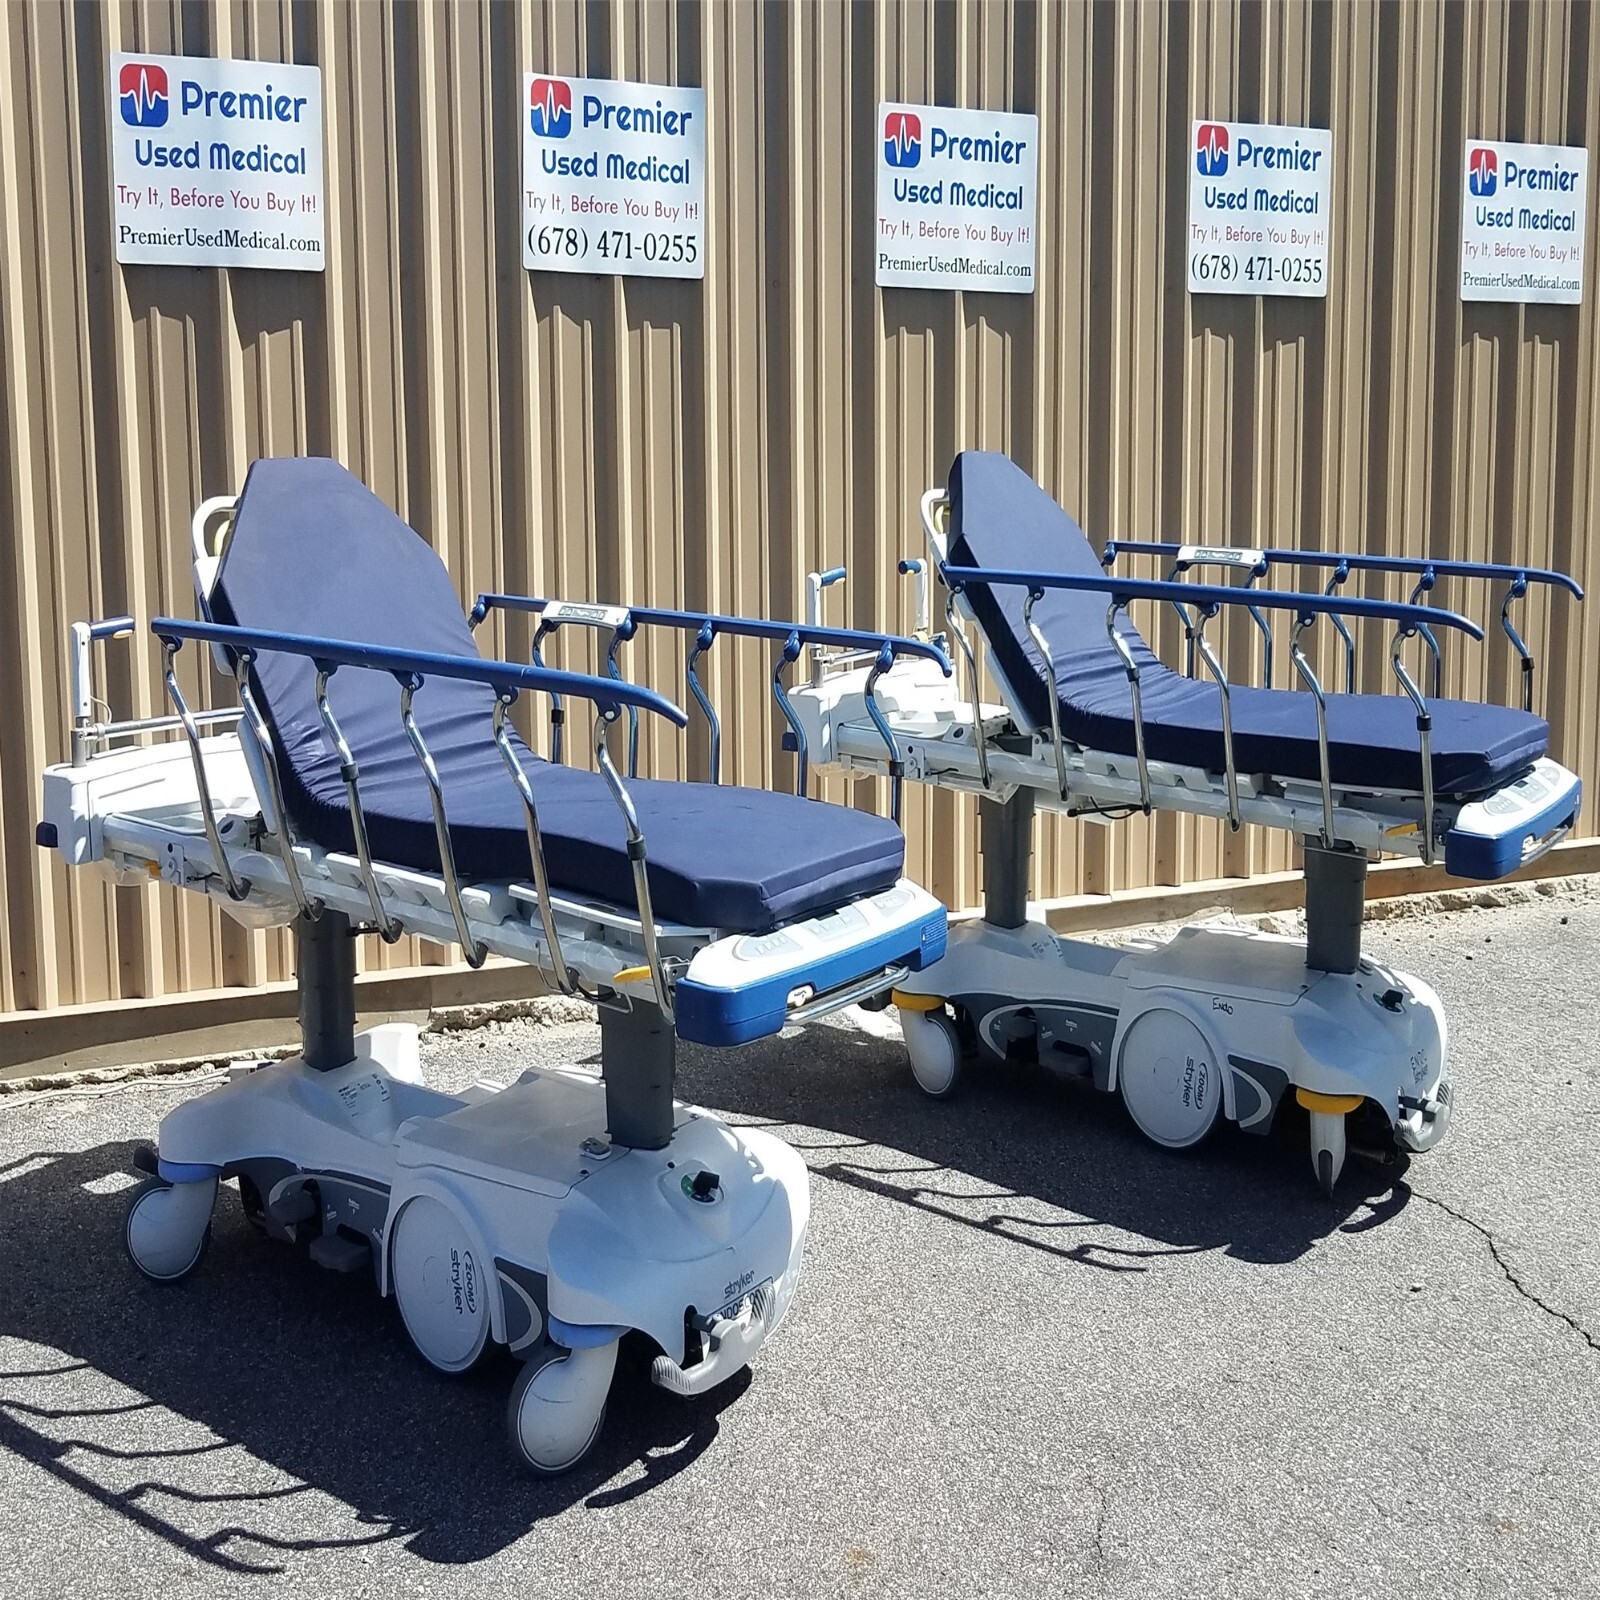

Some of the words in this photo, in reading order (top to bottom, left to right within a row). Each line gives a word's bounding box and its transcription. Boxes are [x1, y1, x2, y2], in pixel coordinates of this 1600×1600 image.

[181, 80, 308, 123] Premier
[583, 95, 693, 136] Premier
[135, 139, 200, 170] Used
[210, 142, 306, 175] Medical
[930, 128, 1026, 165] Premier
[1237, 138, 1322, 172] Premier
[542, 148, 598, 178] Used
[606, 153, 690, 184] Medical
[1504, 161, 1579, 192] Premier
[117, 185, 142, 209] Try
[148, 186, 164, 209] It,
[170, 188, 224, 208] Before
[230, 190, 260, 210] You
[267, 192, 296, 216] Buy
[302, 194, 316, 213] It!
[526, 191, 547, 214] Try
[552, 194, 565, 215] It,
[571, 195, 618, 214] Before
[623, 198, 649, 217] You
[654, 201, 680, 224] Buy
[685, 202, 698, 220] It!
[894, 178, 942, 204] Used
[950, 182, 1023, 210] Medical
[1204, 186, 1248, 210] Used
[1254, 188, 1319, 214] Medical
[878, 218, 897, 240] Try
[902, 220, 914, 240] It,
[919, 220, 960, 240] Before
[964, 224, 986, 241] You
[991, 226, 1014, 246] Buy
[1018, 227, 1030, 244] It!
[1476, 206, 1514, 228] Used
[1518, 208, 1576, 232] Medical
[119, 225, 321, 252] PremierUsedMedical.com
[528, 224, 589, 259] (678)
[596, 230, 698, 264] 471-0255
[1191, 224, 1208, 244] Try
[1211, 225, 1222, 244] It,
[1226, 225, 1263, 243] Before
[1266, 228, 1287, 244] You
[1290, 229, 1310, 248] Buy
[1314, 230, 1324, 246] It!
[878, 253, 1032, 277] PremierUsedMedical.com
[1464, 240, 1479, 260] Try
[1482, 242, 1491, 259] It,
[1494, 242, 1526, 259] Before
[1529, 244, 1546, 260] You
[1550, 246, 1568, 264] Buy
[1570, 246, 1580, 261] It!
[1192, 253, 1239, 282] (678)
[1244, 256, 1322, 284] 471-0255
[1463, 271, 1580, 291] PremierUsedMedical.com
[1182, 1056, 1194, 1107] stryker
[450, 1247, 464, 1315] stryker
[724, 1270, 755, 1300] stryker
